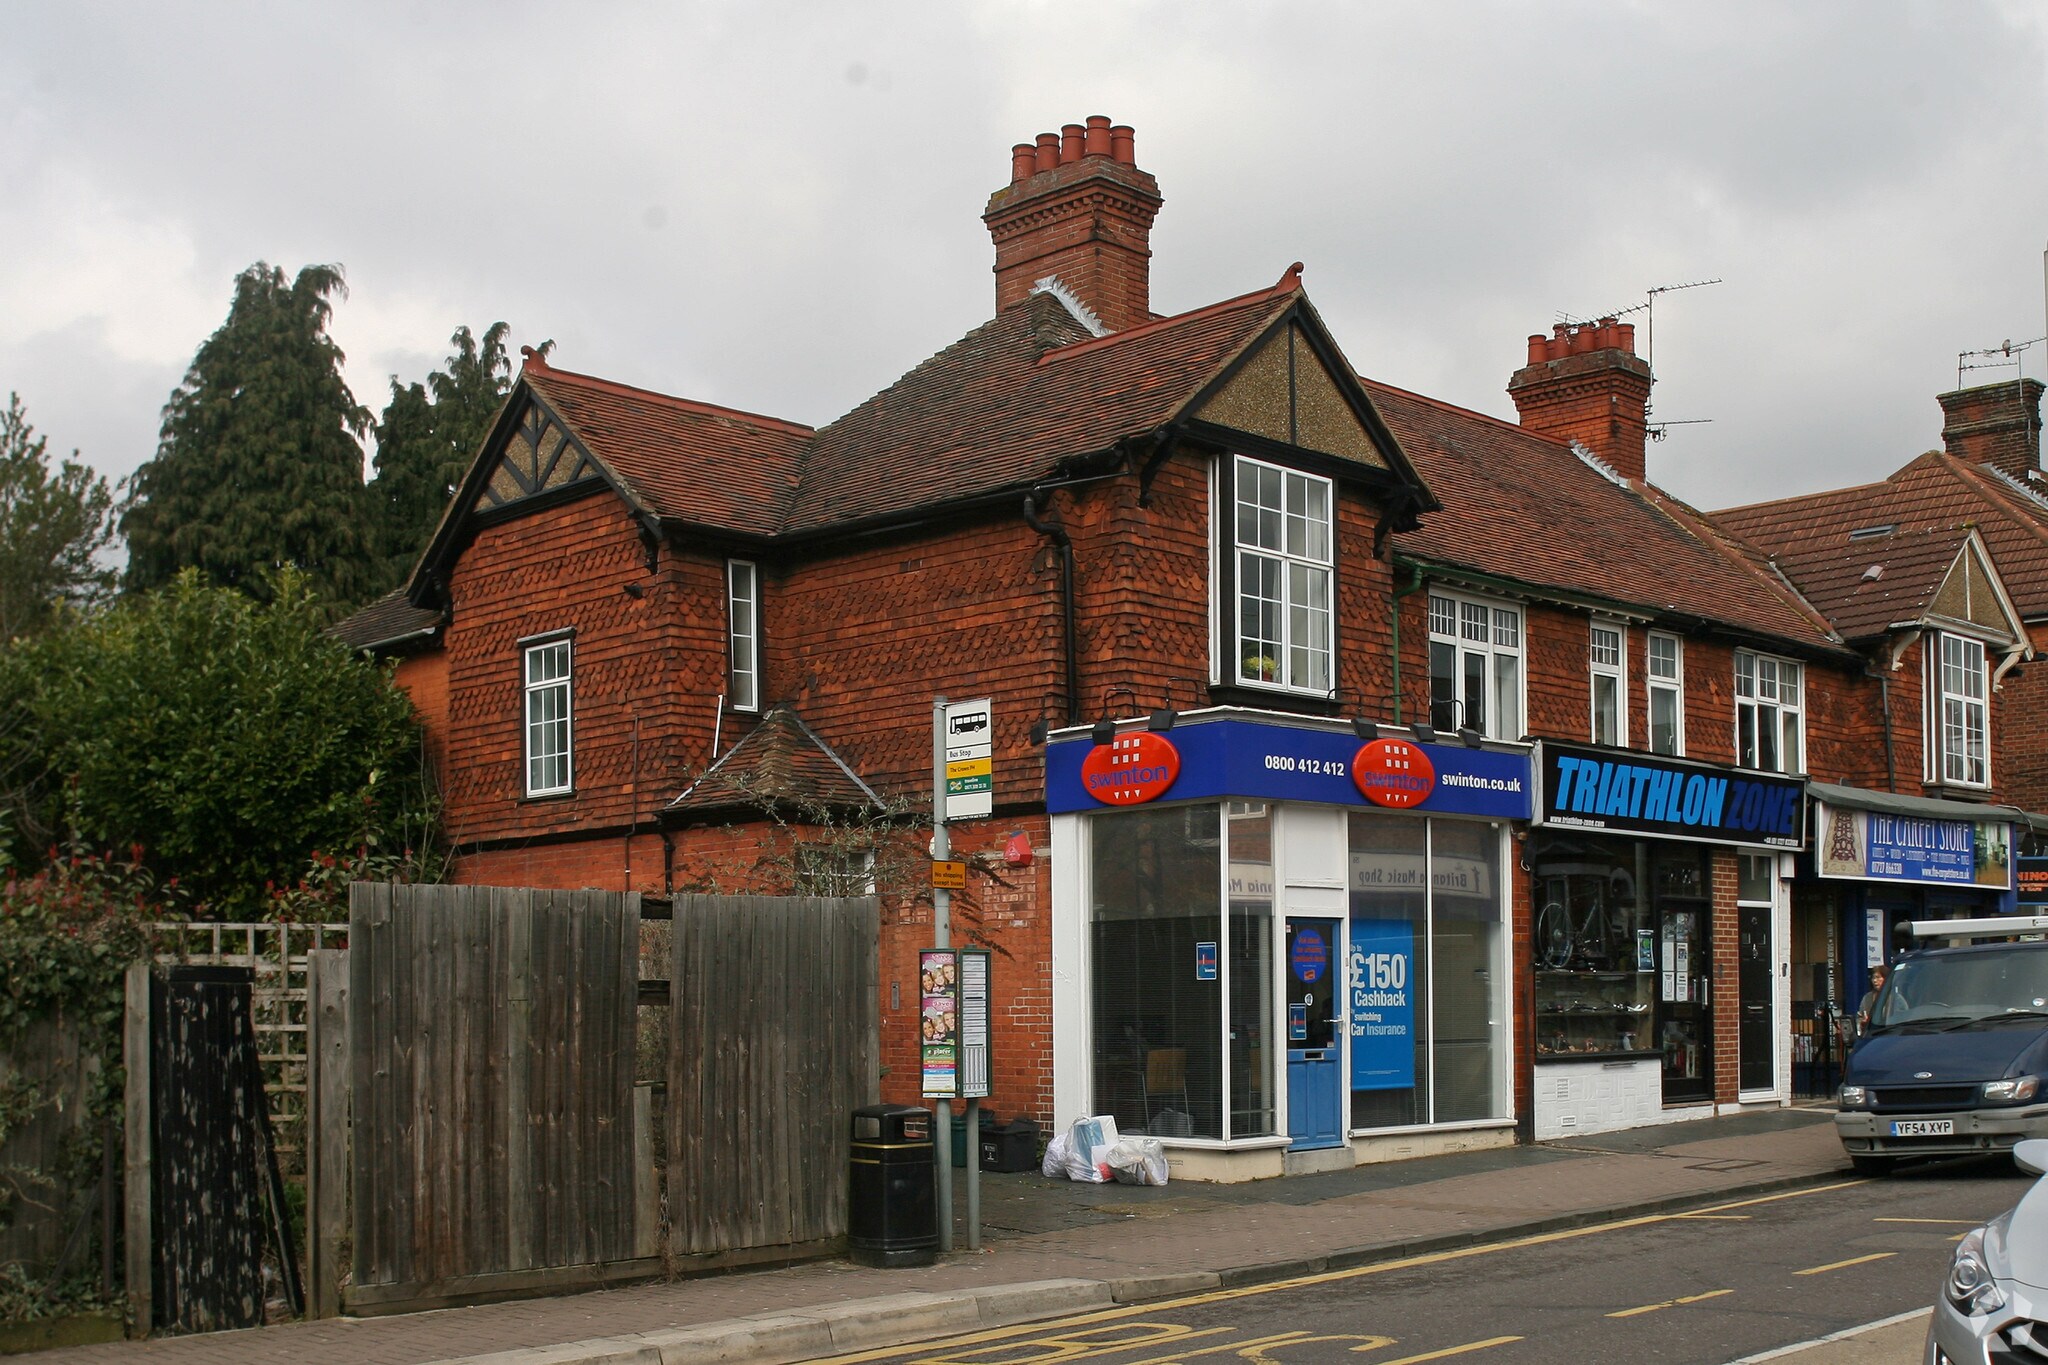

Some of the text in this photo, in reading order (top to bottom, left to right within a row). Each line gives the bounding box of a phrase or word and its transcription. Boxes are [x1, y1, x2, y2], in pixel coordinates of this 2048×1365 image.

[1264, 755, 1344, 776] 0800 412 412
[1089, 765, 1168, 790] swinton
[1364, 771, 1430, 792] swinton
[1442, 772, 1521, 792] swinton.co.uk
[1555, 756, 1799, 834] TRIATHLON ZONE
[1873, 814, 1969, 852] THE CARPET STORE
[1354, 990, 1406, 1007] Cashback
[1354, 1013, 1382, 1022] switching
[1351, 1022, 1406, 1036] Car Insurance
[1897, 1121, 1951, 1134] YF54 XYP
